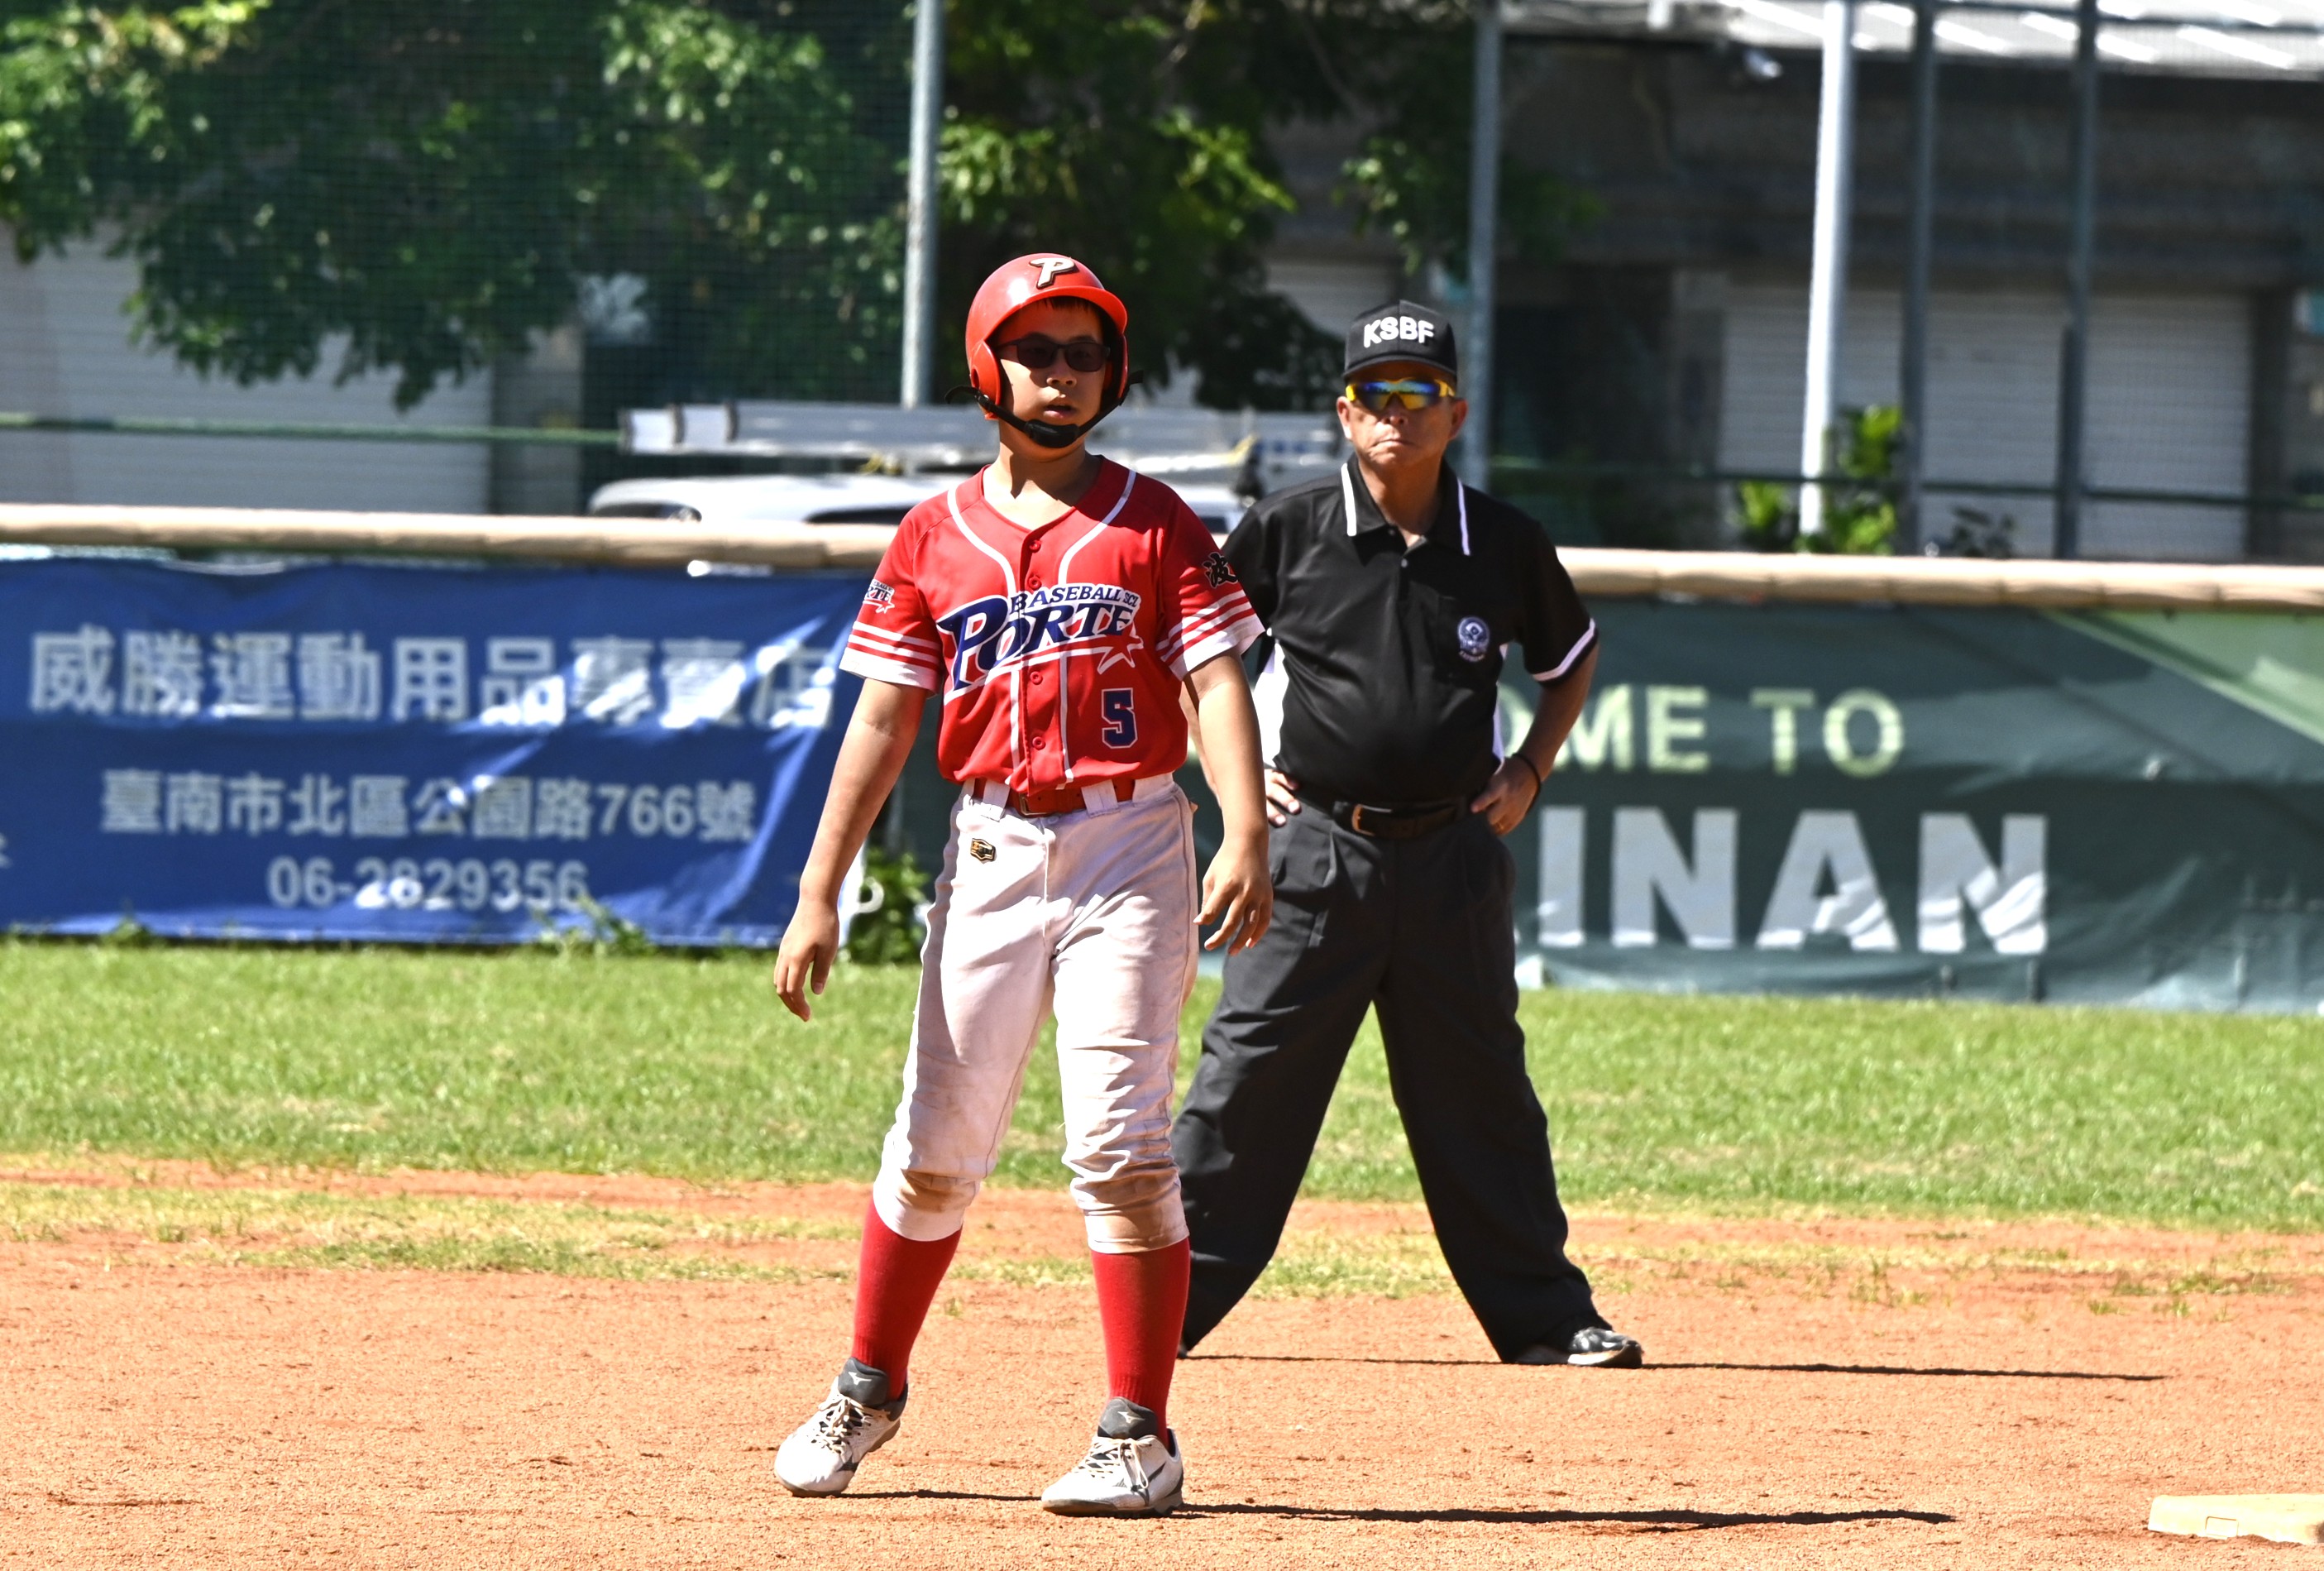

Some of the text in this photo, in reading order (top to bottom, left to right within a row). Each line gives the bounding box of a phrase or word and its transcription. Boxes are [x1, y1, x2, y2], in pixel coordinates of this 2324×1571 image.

[1029, 257, 1078, 290] P
[1364, 316, 1434, 348] KSBF
[867, 586, 892, 601] RTE
[1009, 585, 1121, 614] BASEBALL
[936, 595, 1134, 692] PORTE
[30, 624, 832, 729] 威勝運動用品專賣店
[1101, 687, 1138, 750] 5
[1750, 687, 1906, 778] TO
[101, 767, 756, 843] 臺南市北區公園路766號
[266, 855, 589, 911] 06-2829356
[1537, 805, 2049, 954] INAN
